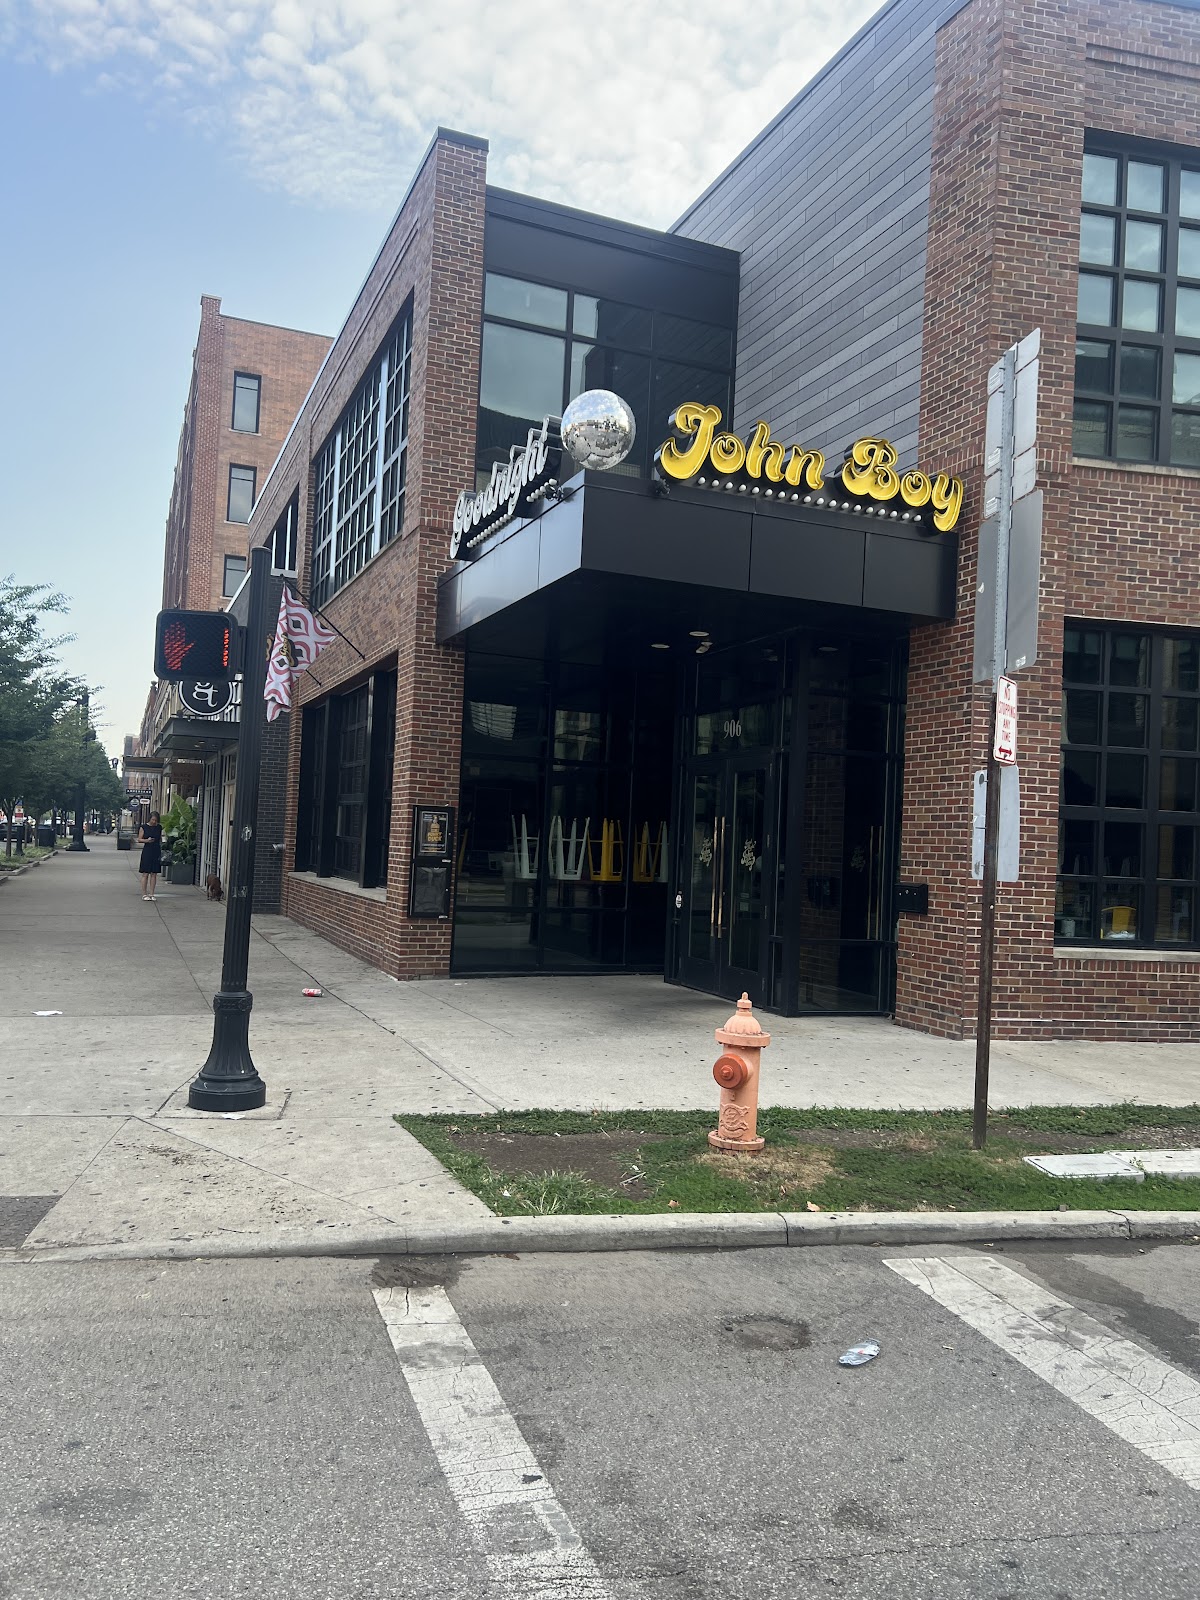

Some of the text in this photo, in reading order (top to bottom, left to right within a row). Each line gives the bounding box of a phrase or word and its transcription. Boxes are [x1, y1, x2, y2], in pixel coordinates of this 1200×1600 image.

[657, 401, 965, 533] John Boy
[1004, 687, 1010, 700] NO
[724, 719, 742, 739] 906
